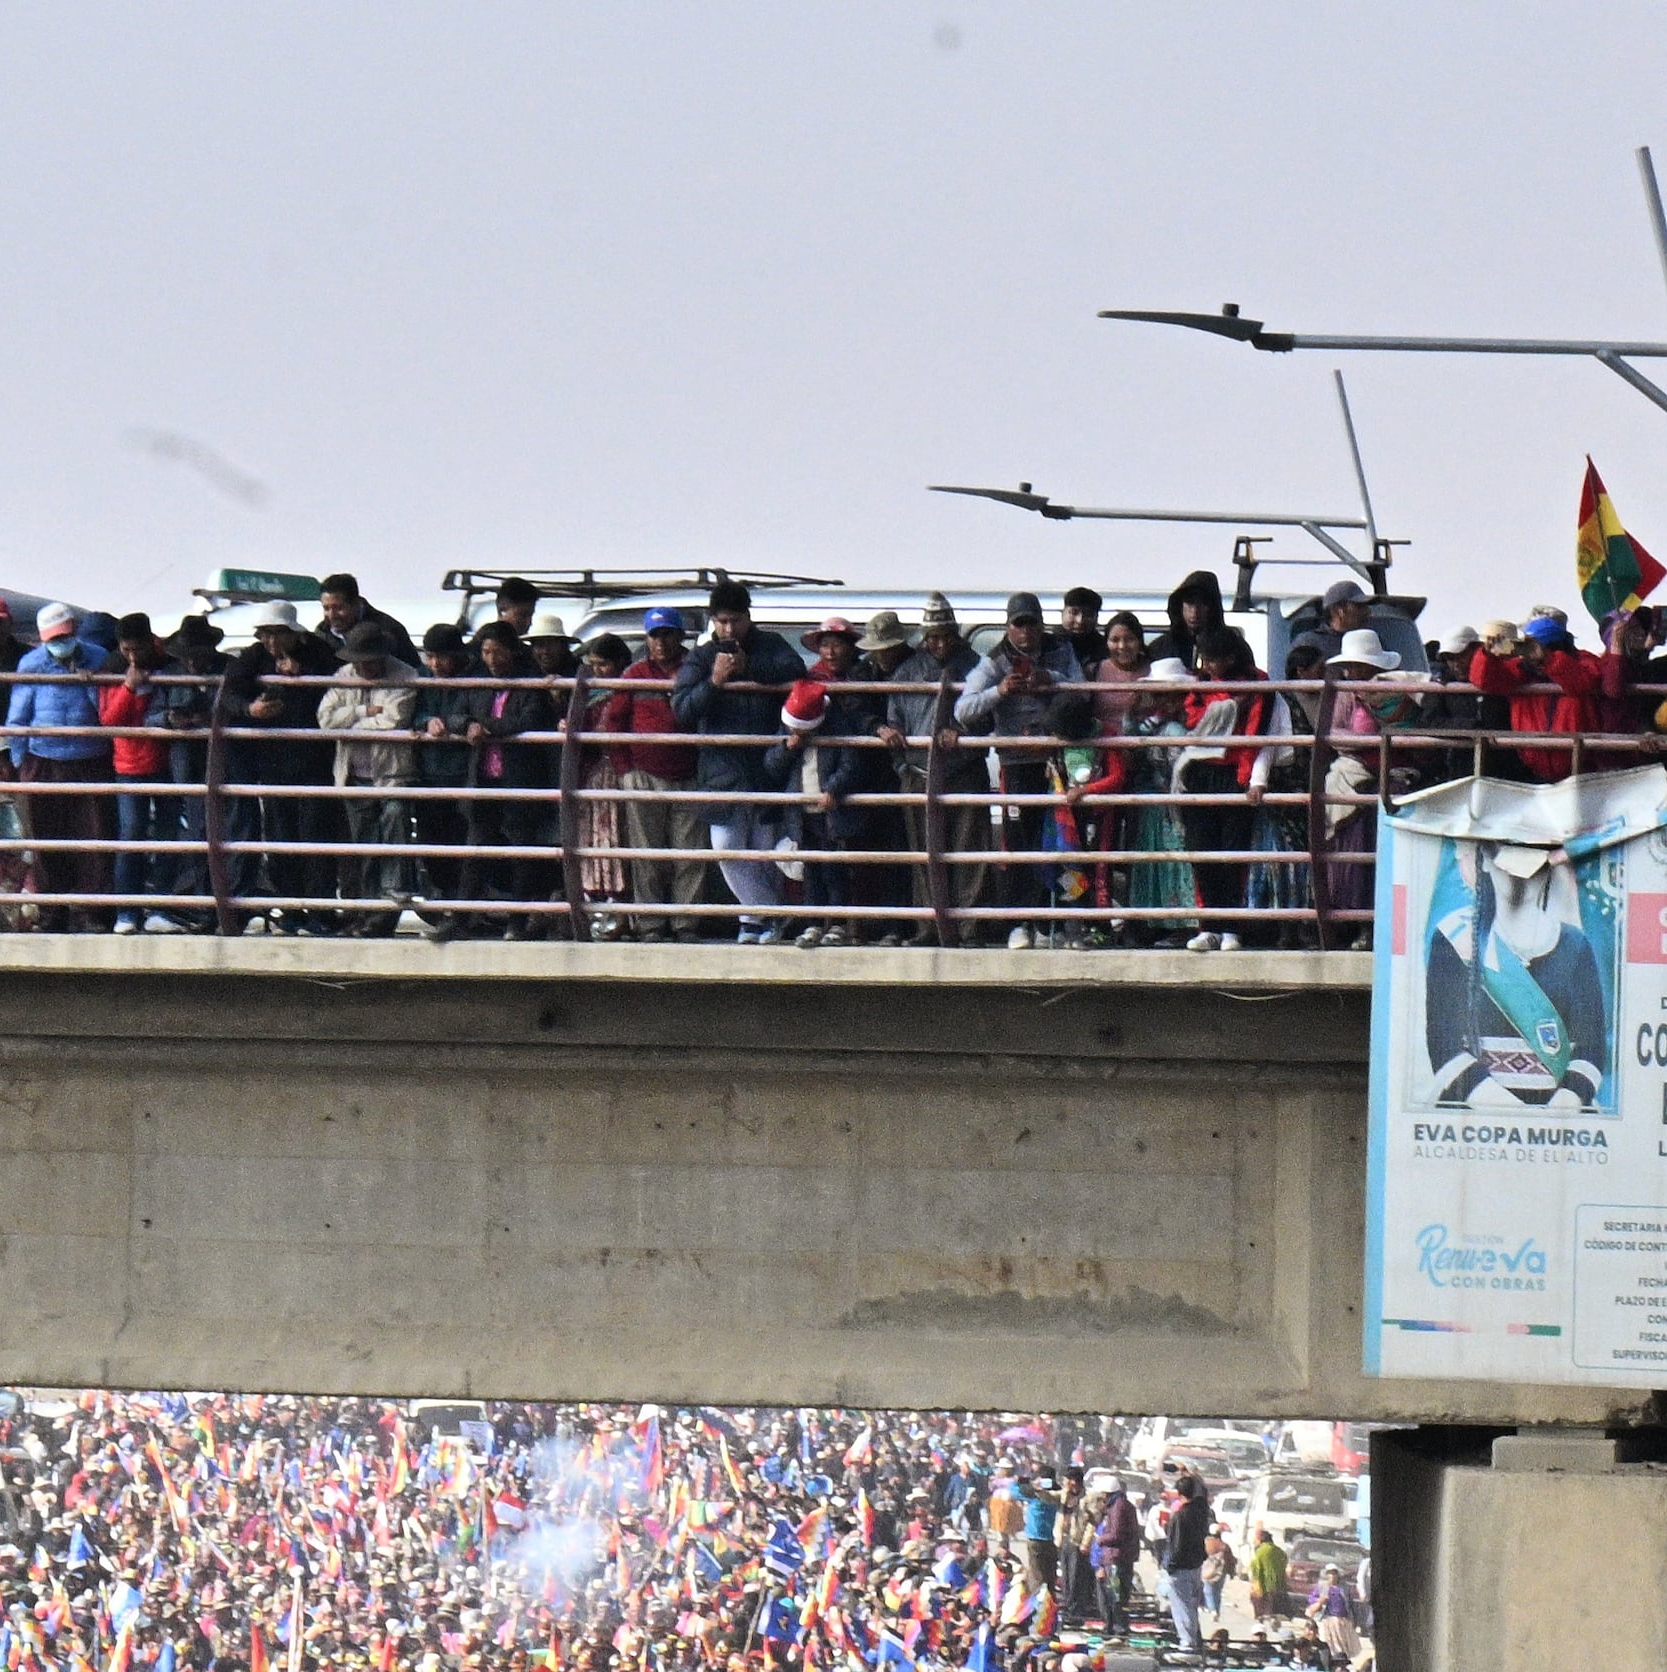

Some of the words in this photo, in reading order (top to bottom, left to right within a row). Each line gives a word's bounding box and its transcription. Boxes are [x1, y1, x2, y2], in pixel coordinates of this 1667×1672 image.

[1414, 1124, 1457, 1142] EVA
[1462, 1126, 1522, 1145] COPA
[1528, 1128, 1608, 1148] MURGA
[1414, 1145, 1508, 1161] ALCALDESA
[1516, 1148, 1535, 1162] DE
[1543, 1149, 1559, 1163] EL
[1567, 1150, 1609, 1165] ALTO
[1625, 1242, 1637, 1251] DE
[1451, 1276, 1485, 1289] CON
[1490, 1277, 1547, 1291] OBRAS
[1615, 1296, 1646, 1306] PLAZO
